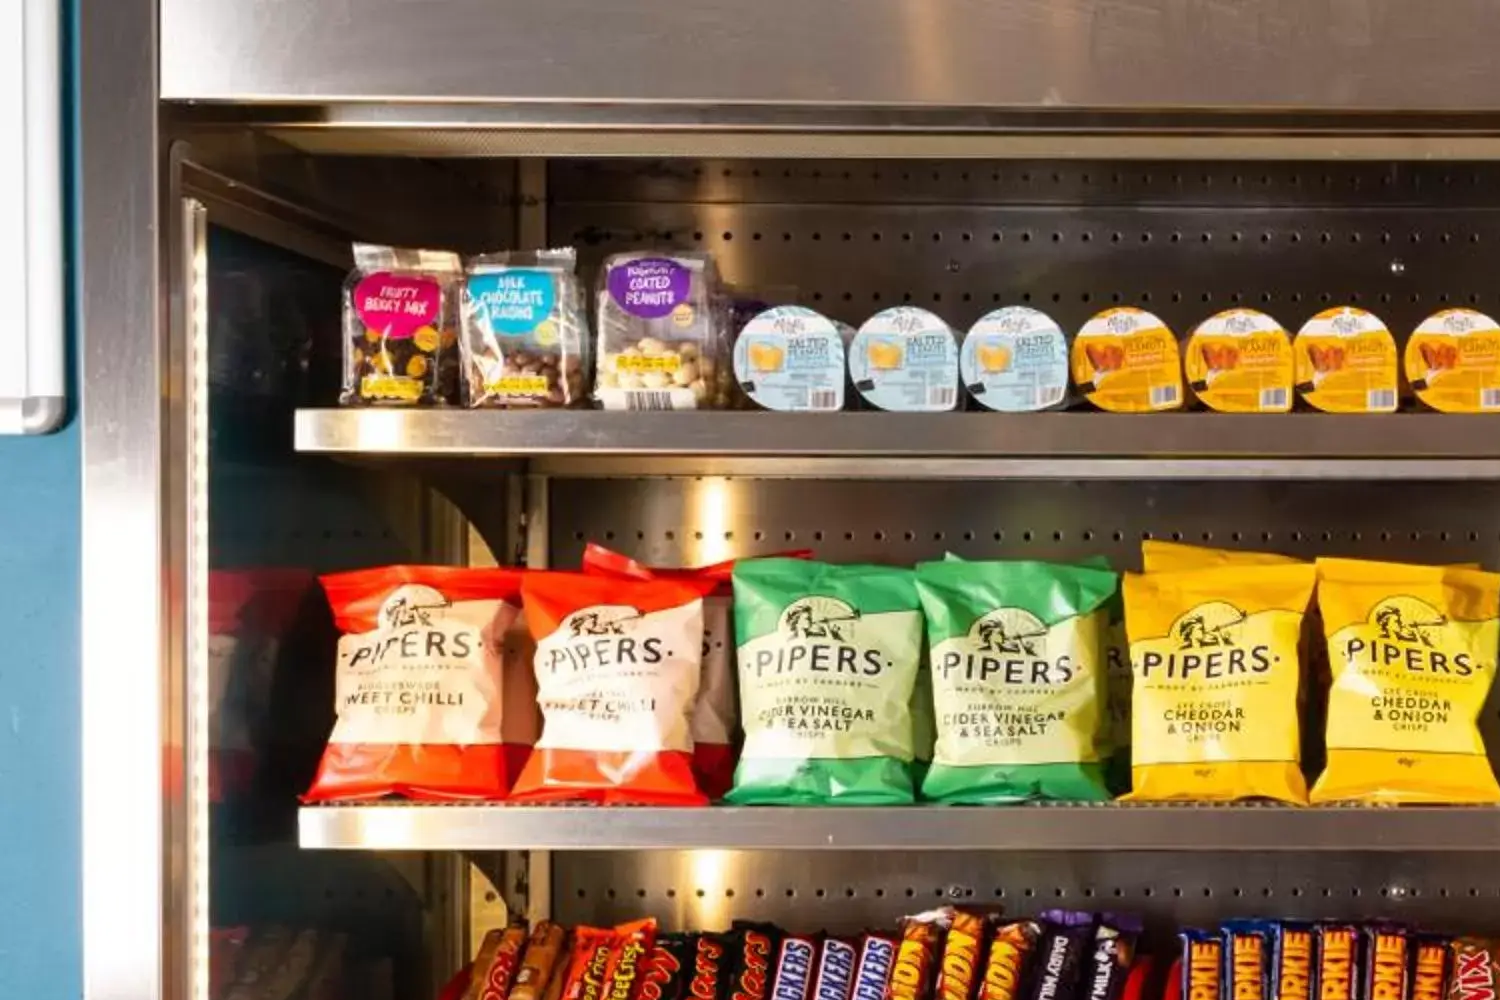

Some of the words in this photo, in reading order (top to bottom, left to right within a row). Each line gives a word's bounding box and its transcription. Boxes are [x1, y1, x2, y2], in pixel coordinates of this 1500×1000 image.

[550, 638, 662, 675] PIPERS
[755, 644, 883, 678] PIPERS
[1141, 646, 1270, 679] PIPERS
[1347, 637, 1474, 678] PIPERS
[942, 651, 1073, 685] PIPERS
[346, 690, 394, 706] WEET
[399, 690, 465, 706] CHILLI
[1371, 696, 1452, 711] CHEDDAR
[799, 705, 876, 721] VINEGAR
[943, 713, 989, 725] CIDER
[993, 711, 1066, 725] VINEGAR
[1163, 707, 1246, 721] CHEDDAR
[1373, 709, 1384, 721] &
[1387, 709, 1449, 723] ONION
[813, 719, 855, 733] SALT
[973, 726, 1003, 738] SEA
[1007, 724, 1048, 737] SALT
[1181, 721, 1241, 733] ONION
[1046, 935, 1068, 976] DAIRY
[1093, 962, 1112, 999] MILK
